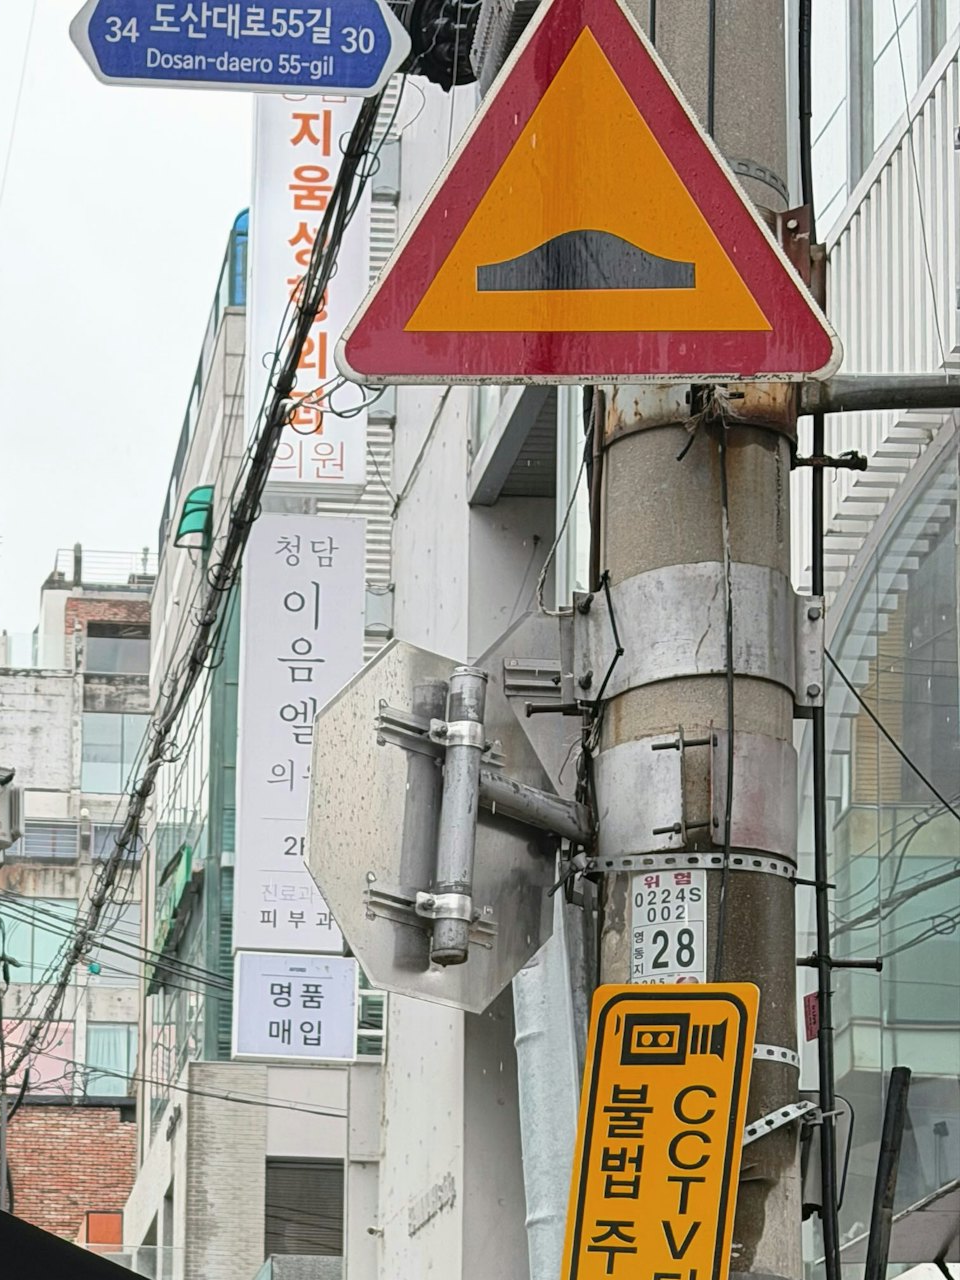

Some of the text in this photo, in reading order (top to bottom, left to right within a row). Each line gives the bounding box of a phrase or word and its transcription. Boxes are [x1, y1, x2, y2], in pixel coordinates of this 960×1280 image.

[105, 1, 375, 54] 34 도산대로55길 30
[146, 48, 333, 79] Dosan-daero 55-gil
[273, 440, 345, 479] 의원
[275, 535, 339, 567] 청담
[277, 580, 326, 744] 이음엘
[267, 759, 310, 791] 의
[262, 884, 324, 904] 진료과
[635, 887, 701, 908] 0224S
[647, 905, 686, 922] 002
[634, 931, 644, 975] 영동지
[652, 928, 695, 969] 28
[270, 982, 324, 1009] 명품
[269, 1019, 321, 1046] 매입
